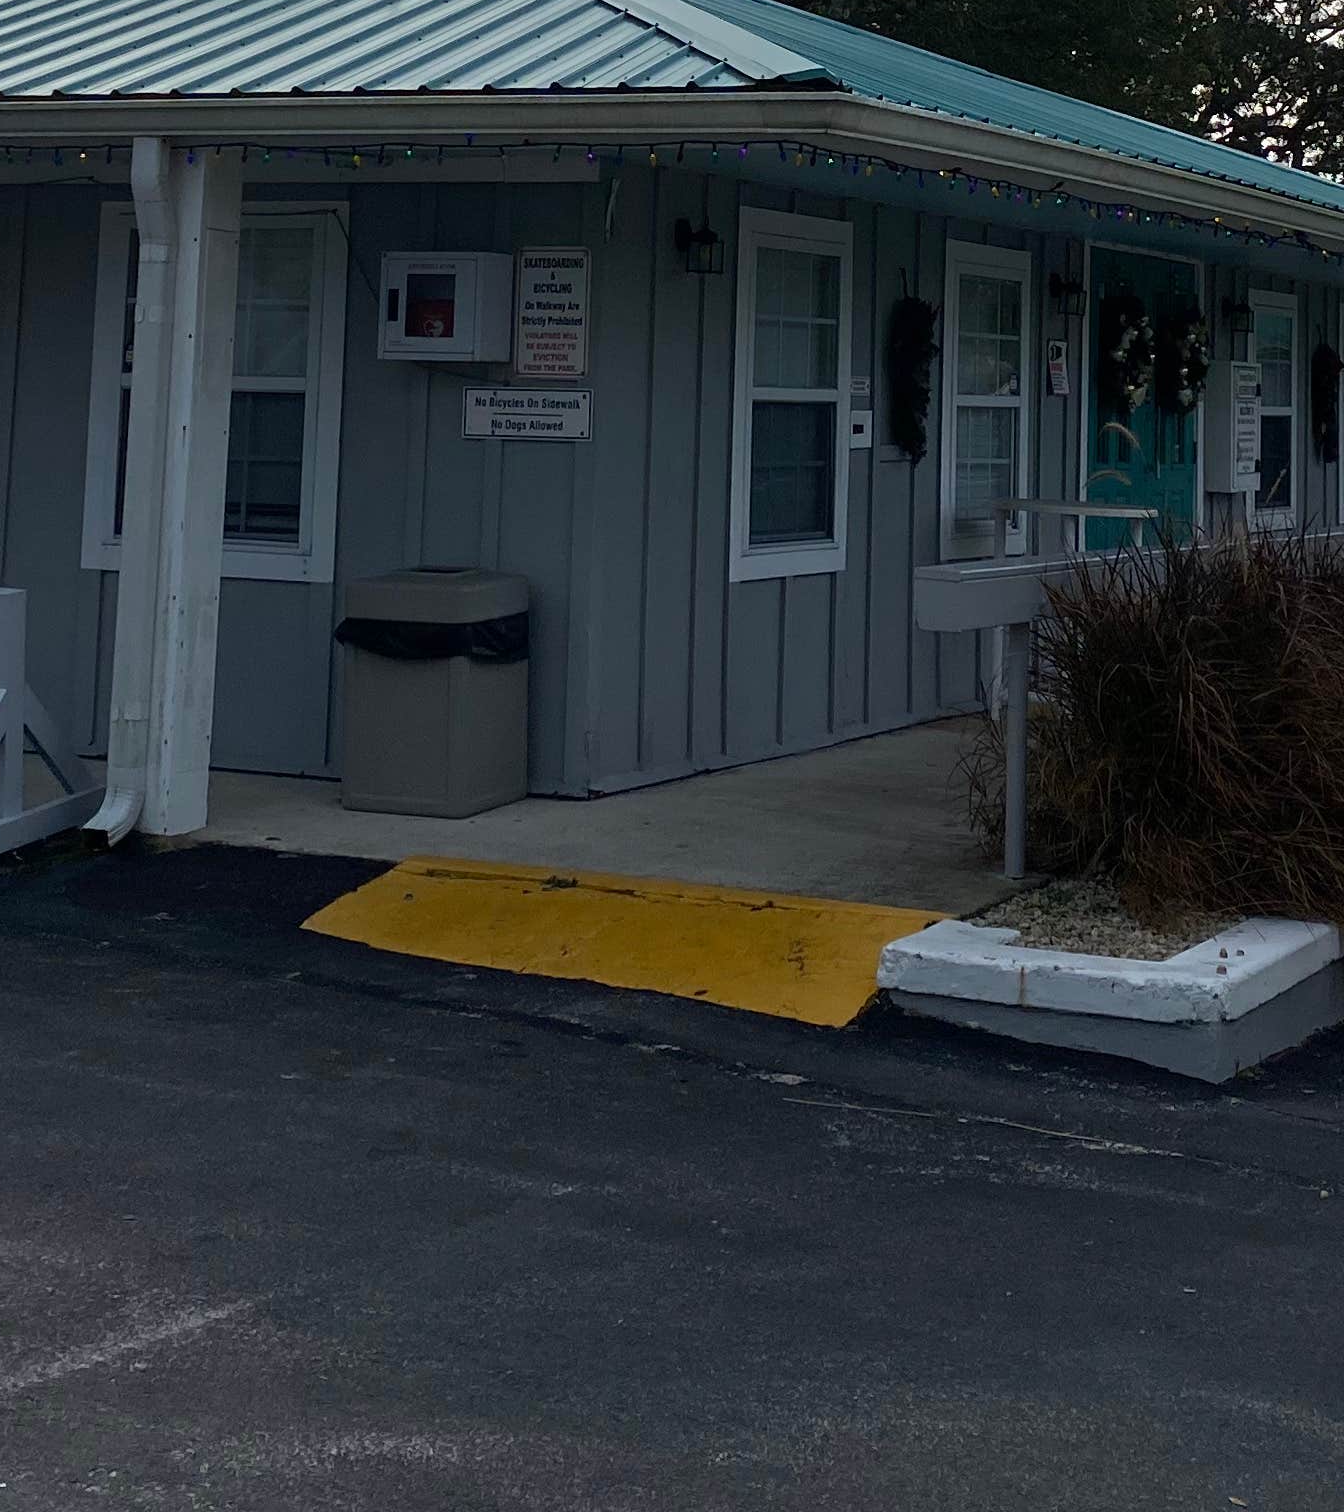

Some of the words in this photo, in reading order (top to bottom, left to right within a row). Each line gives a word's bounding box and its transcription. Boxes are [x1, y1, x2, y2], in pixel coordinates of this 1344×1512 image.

[533, 283, 572, 294] BICYCLING
[568, 301, 580, 310] Are
[521, 316, 546, 327] Strictly
[548, 316, 583, 326] Prohibited
[533, 353, 569, 362] EVICTION
[475, 397, 486, 407] No
[489, 397, 525, 409] Bicycles
[527, 398, 539, 408] On
[541, 398, 580, 409] Sidewalk
[491, 419, 503, 430] No
[505, 419, 527, 432] Dogs
[529, 420, 563, 431] Allowed
